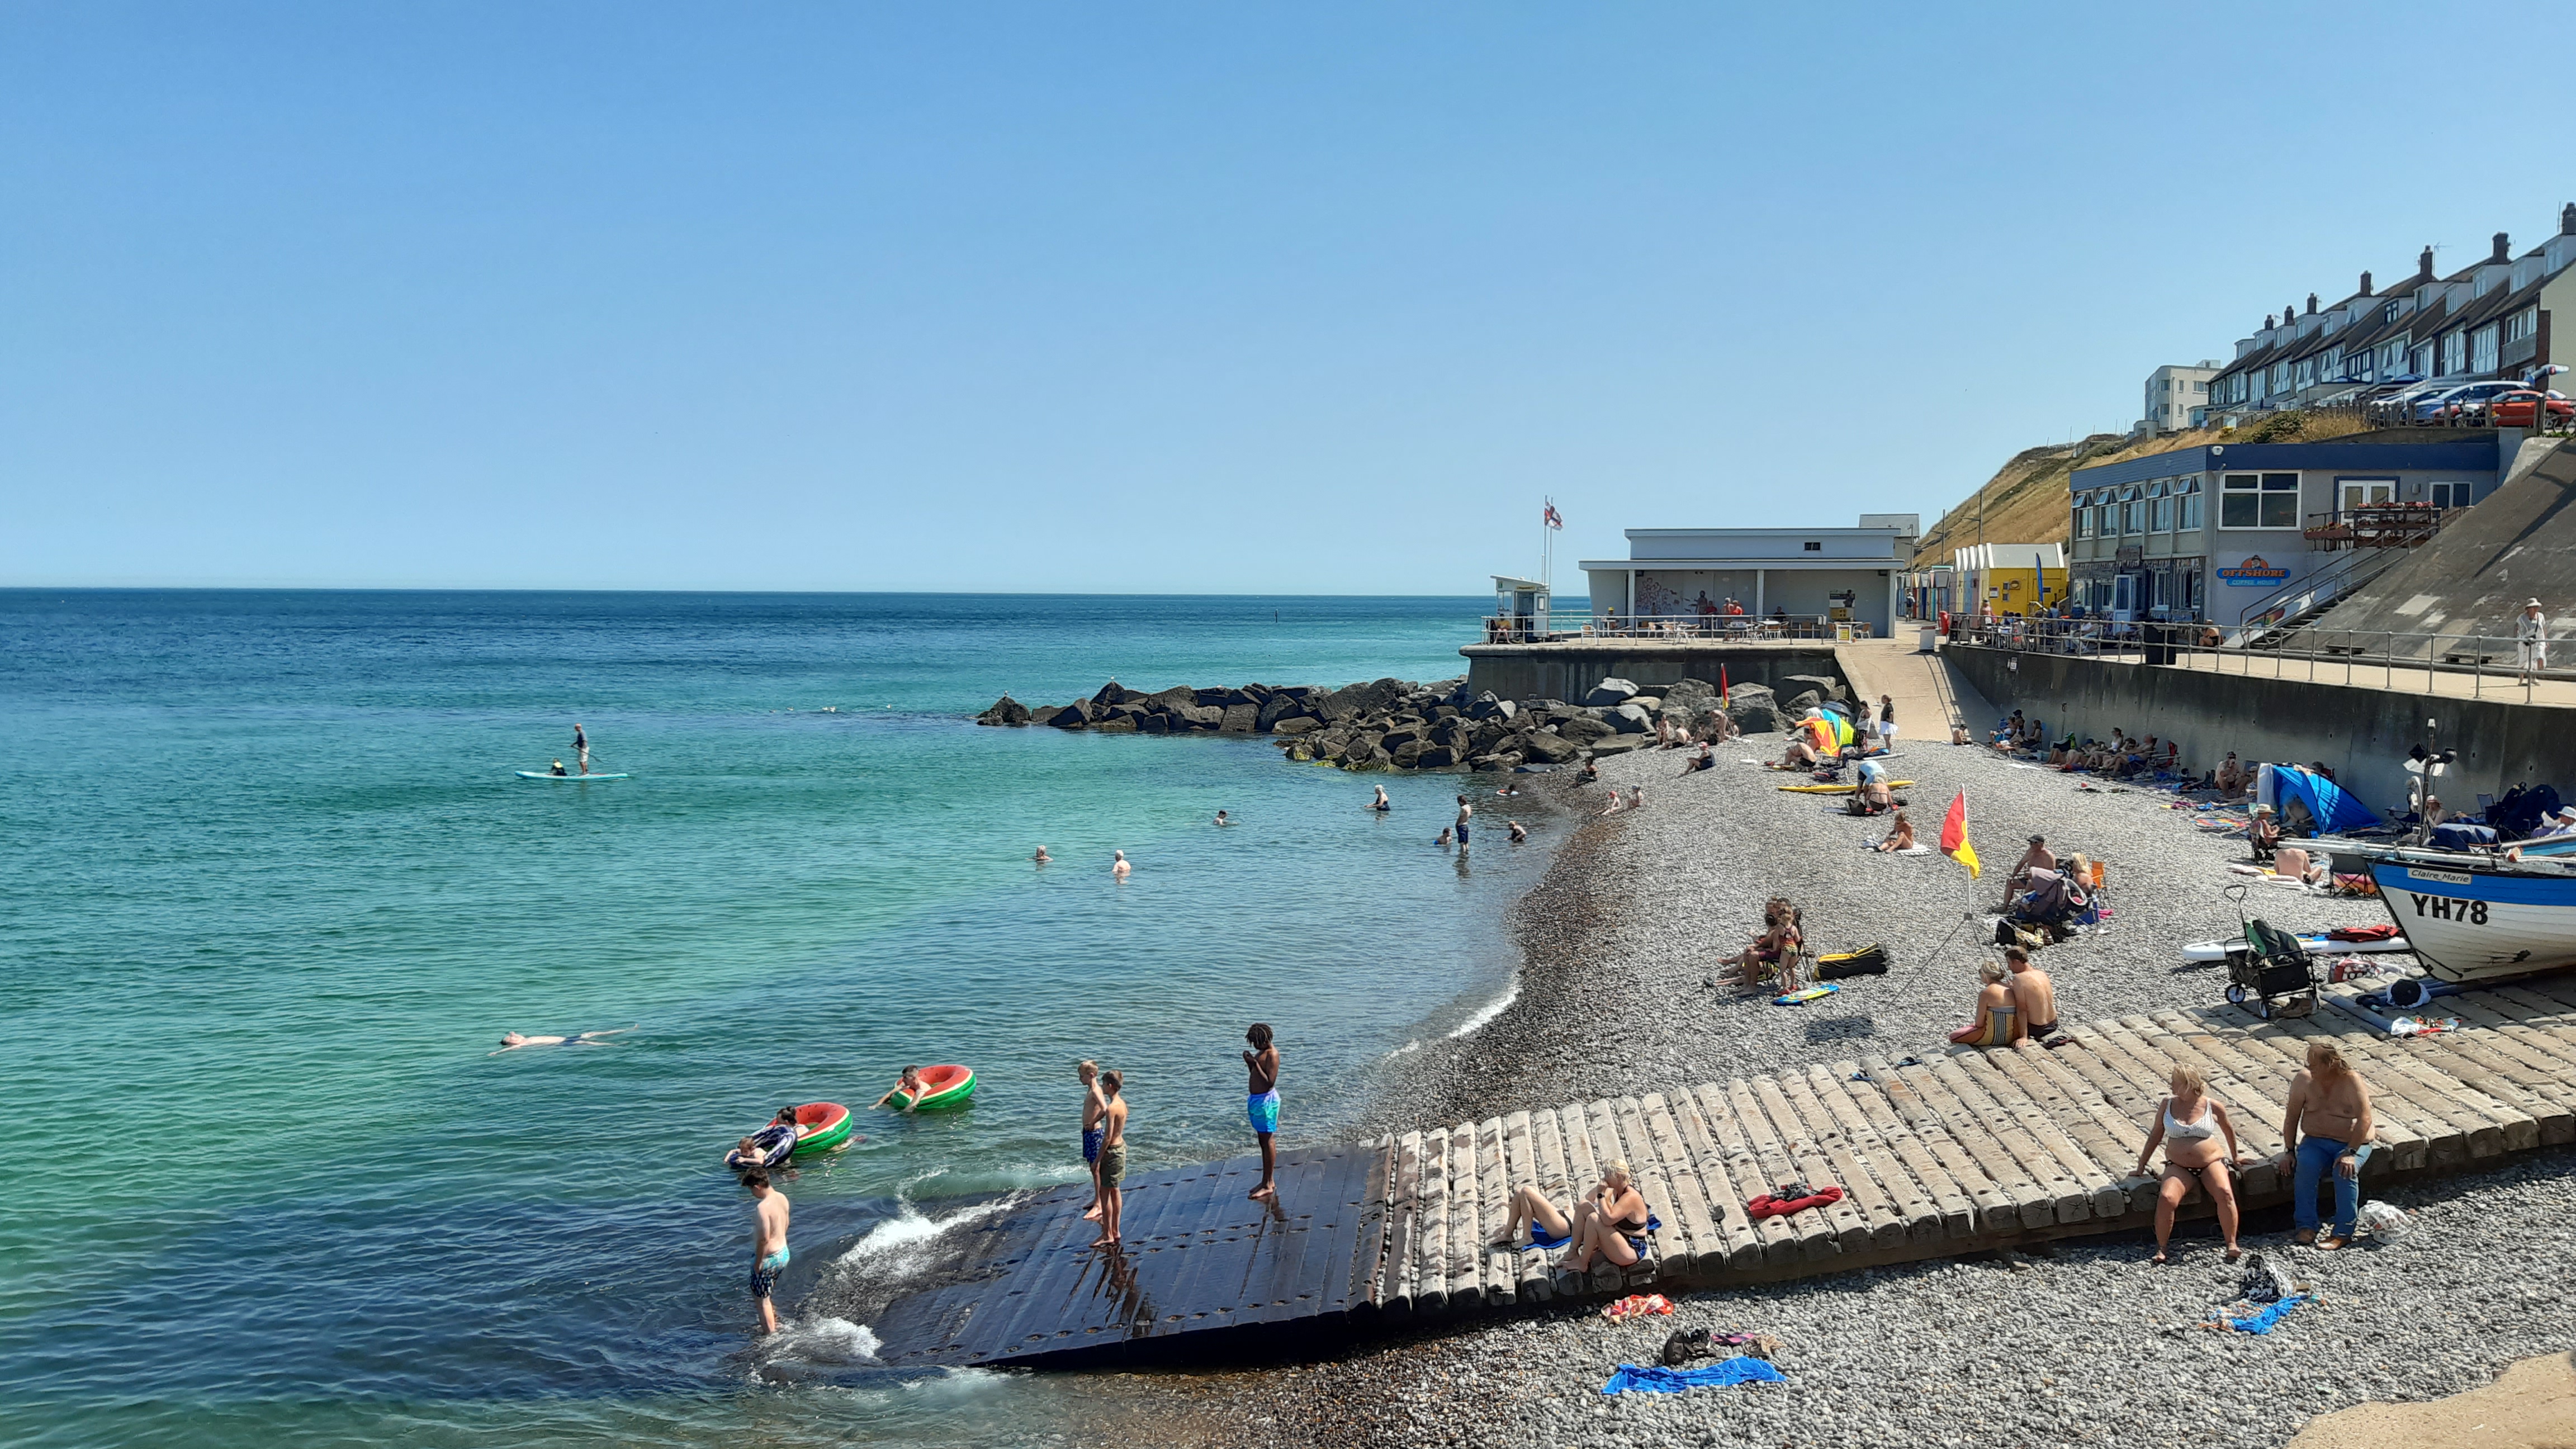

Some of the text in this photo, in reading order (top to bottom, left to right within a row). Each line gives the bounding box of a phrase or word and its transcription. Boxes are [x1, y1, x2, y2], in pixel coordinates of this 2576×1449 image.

[2411, 870, 2469, 882] Claire Marie
[2410, 893, 2488, 925] YH78
